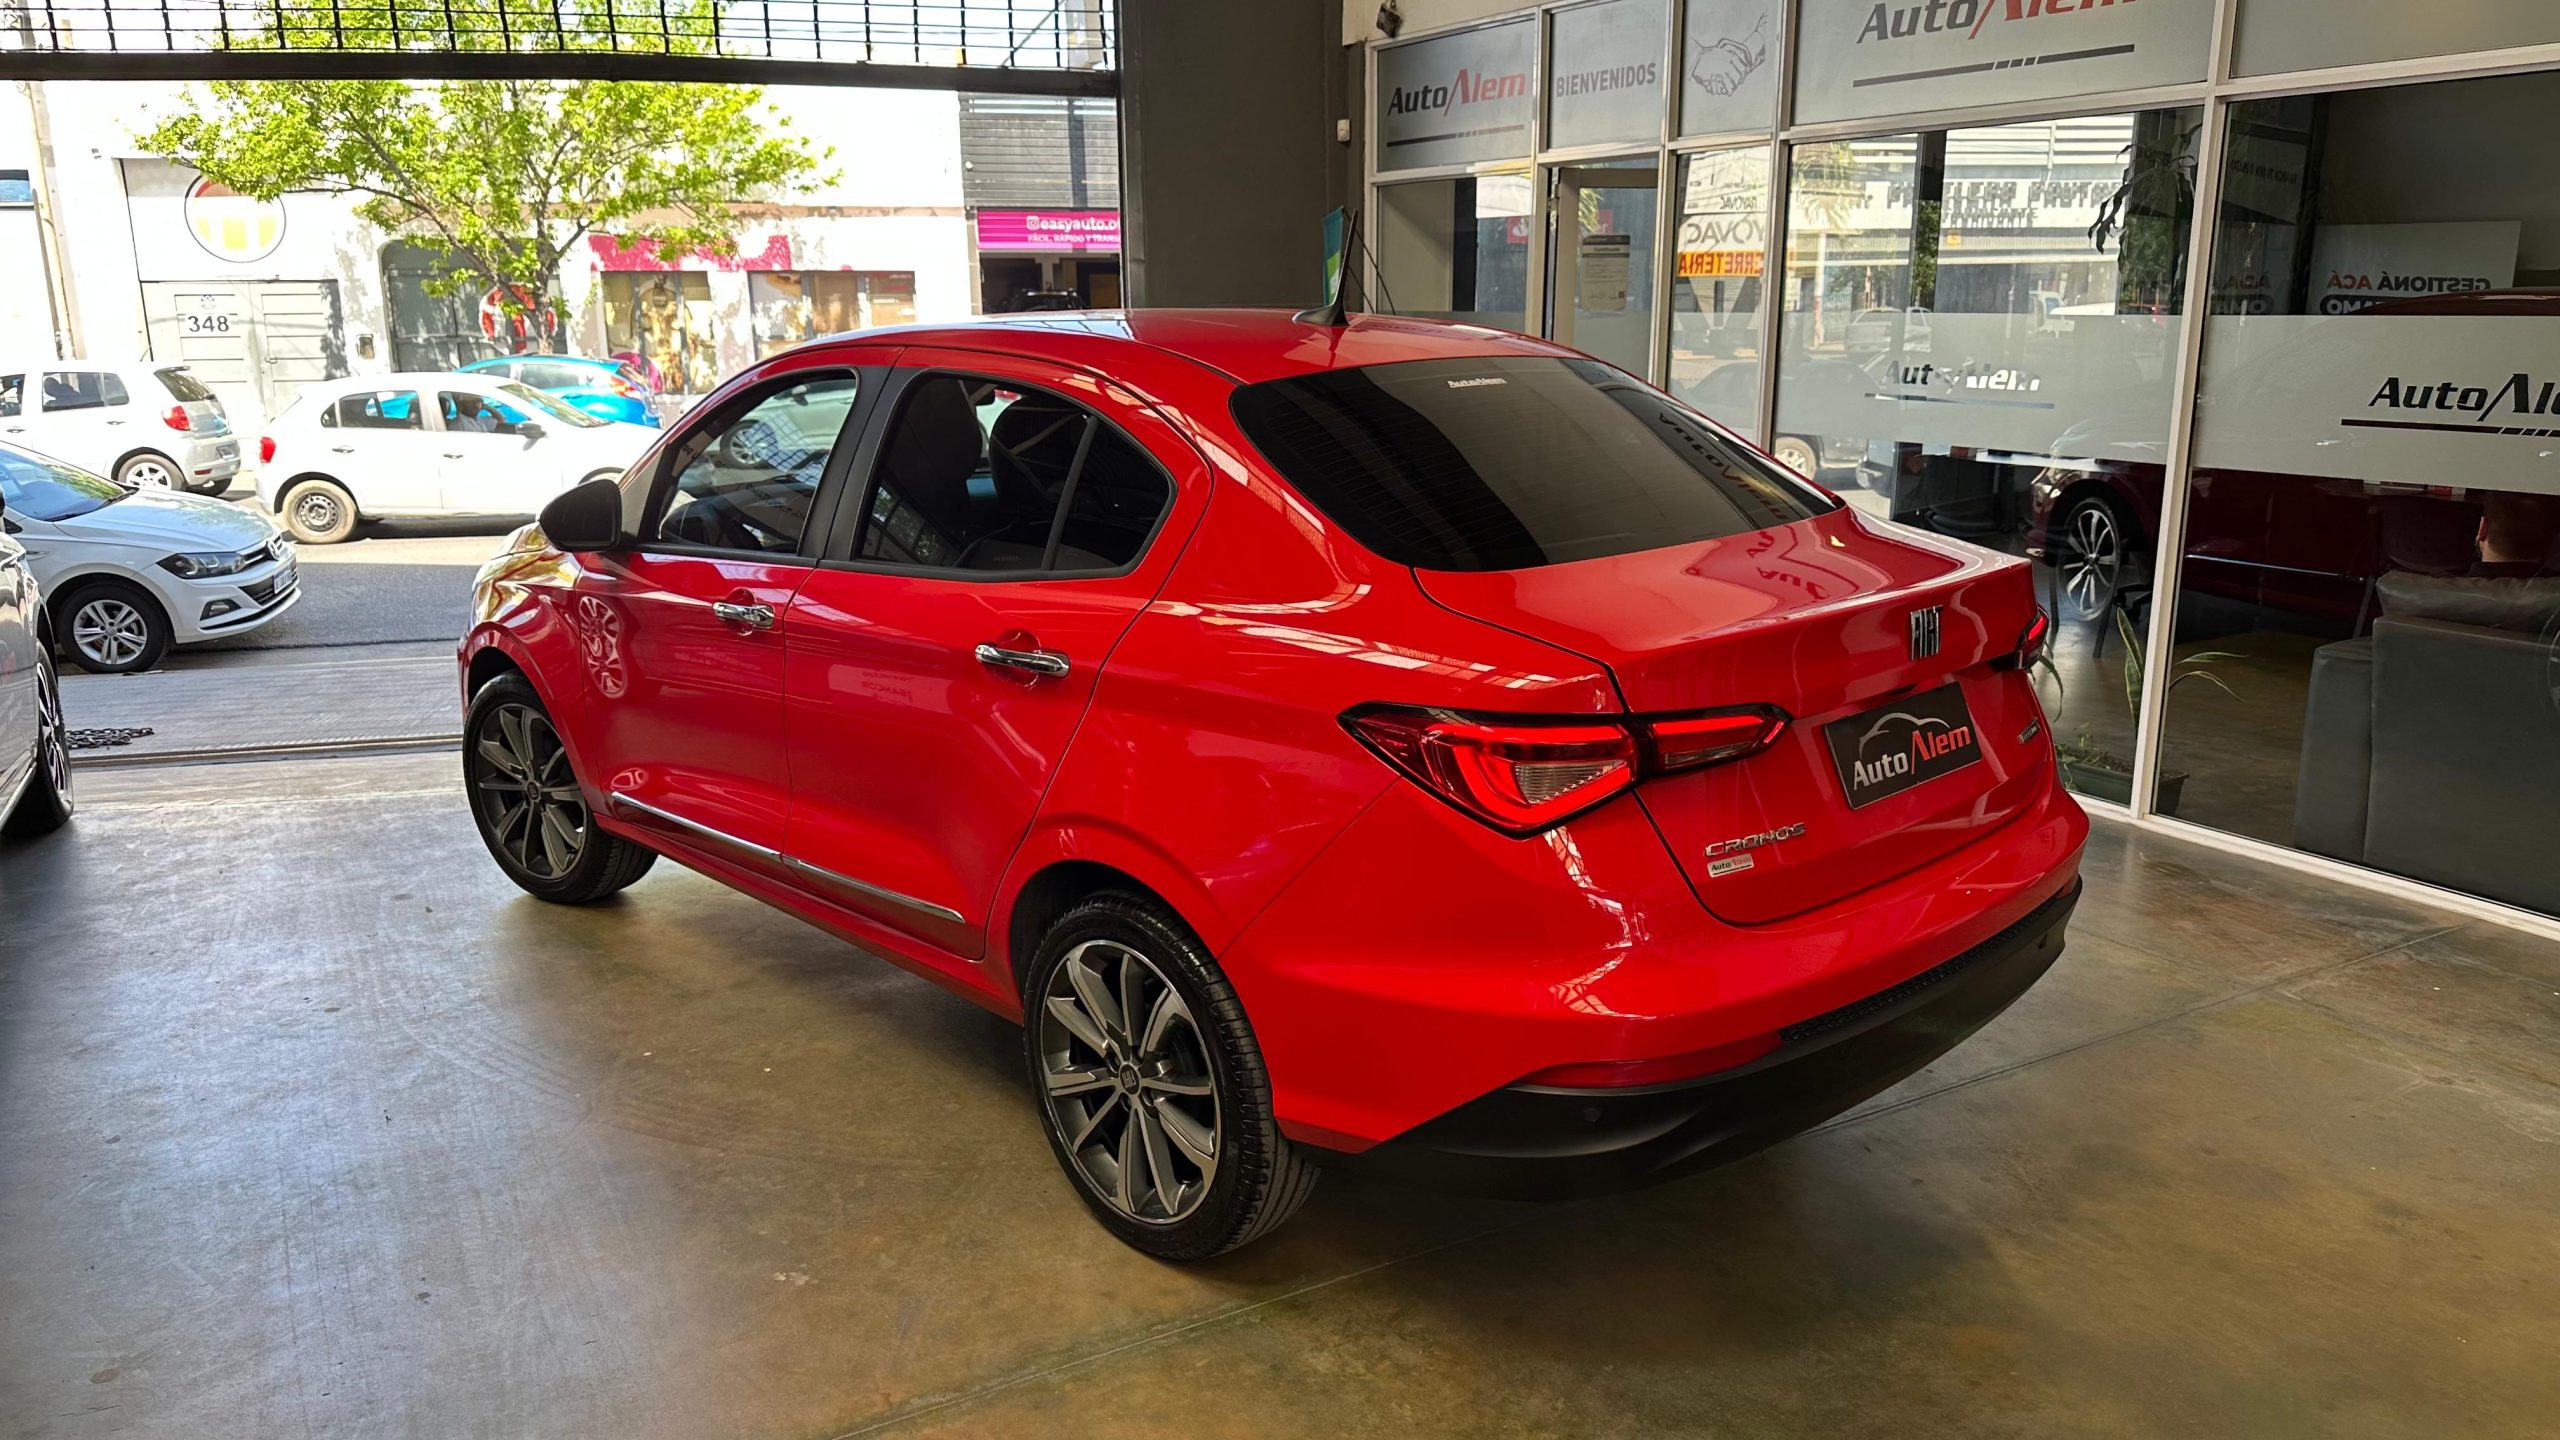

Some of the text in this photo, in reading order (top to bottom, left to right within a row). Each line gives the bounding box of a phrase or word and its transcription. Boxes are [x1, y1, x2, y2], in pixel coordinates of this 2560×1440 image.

[1387, 68, 1526, 117] AutoAlem
[1555, 63, 1657, 98] BIENVENIDOS
[187, 315, 230, 332] 348
[1910, 605, 1943, 662] FIAT
[1703, 822, 1806, 857] CRONOS
